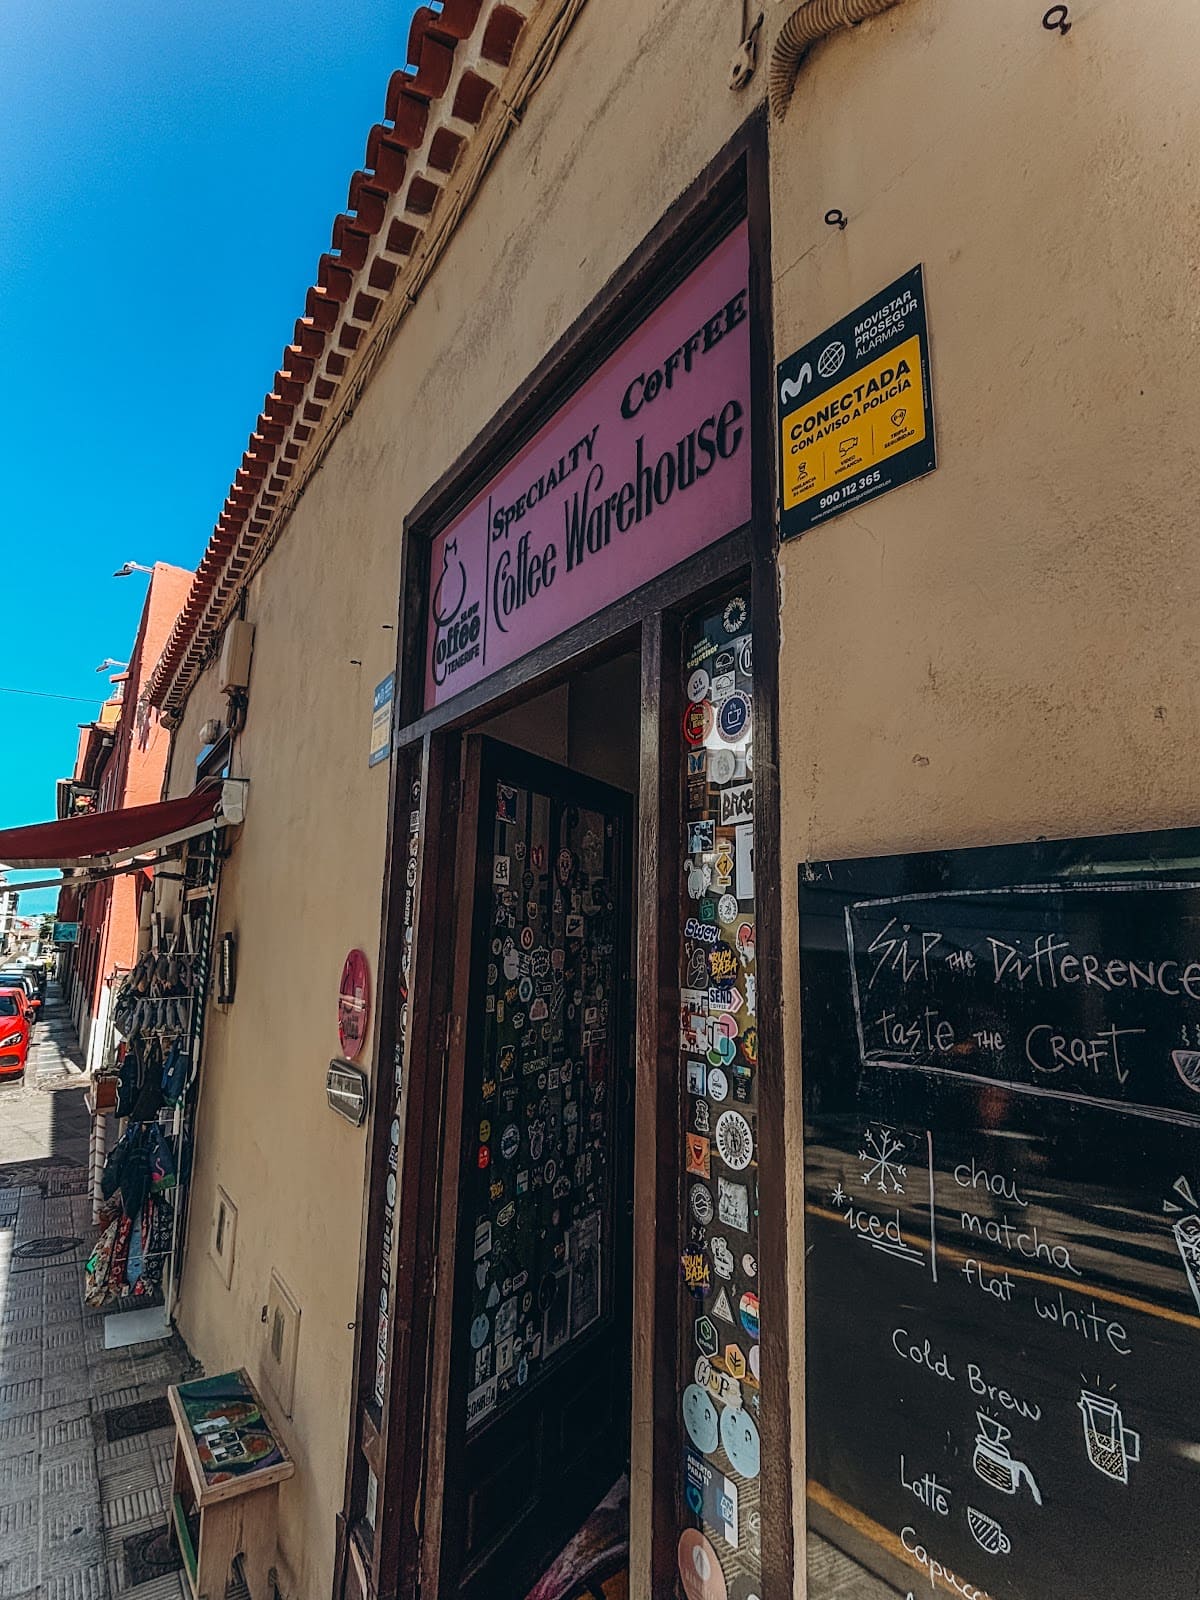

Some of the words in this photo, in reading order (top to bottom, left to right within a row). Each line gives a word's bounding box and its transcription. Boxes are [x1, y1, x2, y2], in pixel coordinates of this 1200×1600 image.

[854, 290, 911, 336] MOVISTAR
[855, 299, 918, 348] PROSEGUR
[856, 320, 905, 359] ALARMAS
[492, 424, 600, 542] SPECIALTY
[620, 288, 747, 420] COFFEE
[790, 359, 911, 441] CONECTADA
[790, 434, 814, 455] CON
[816, 415, 850, 442] AVISO
[852, 408, 861, 420] A
[863, 378, 911, 413] POLICÍA
[884, 429, 915, 449] SEGURIDAD
[890, 427, 908, 439] TRIPLE
[834, 457, 863, 475] VIGILANCIA
[840, 455, 856, 466] VIDEO
[791, 476, 816, 492] VIGILANCIA
[819, 491, 840, 509] 900
[841, 482, 857, 499] 112
[858, 470, 881, 489] 365
[493, 531, 557, 633] Coffee
[564, 400, 744, 573] Warehouse
[447, 643, 480, 676] TENERIFE
[709, 949, 732, 963] RUM
[711, 957, 737, 976] BABA
[710, 990, 732, 1004] SEND
[954, 1158, 1028, 1206] chai
[844, 1197, 907, 1247] iced
[684, 1254, 704, 1269] RUM
[961, 1212, 1082, 1275] matcha
[685, 1264, 710, 1282] BABA
[962, 1259, 1016, 1302] flat
[1034, 1291, 1132, 1356] white
[891, 1329, 955, 1381] Cold
[967, 1364, 1041, 1421] Brew
[687, 1454, 712, 1479] ABIERTO
[687, 1463, 703, 1482] PARA
[703, 1475, 709, 1487] TI
[900, 1454, 951, 1516] Latte
